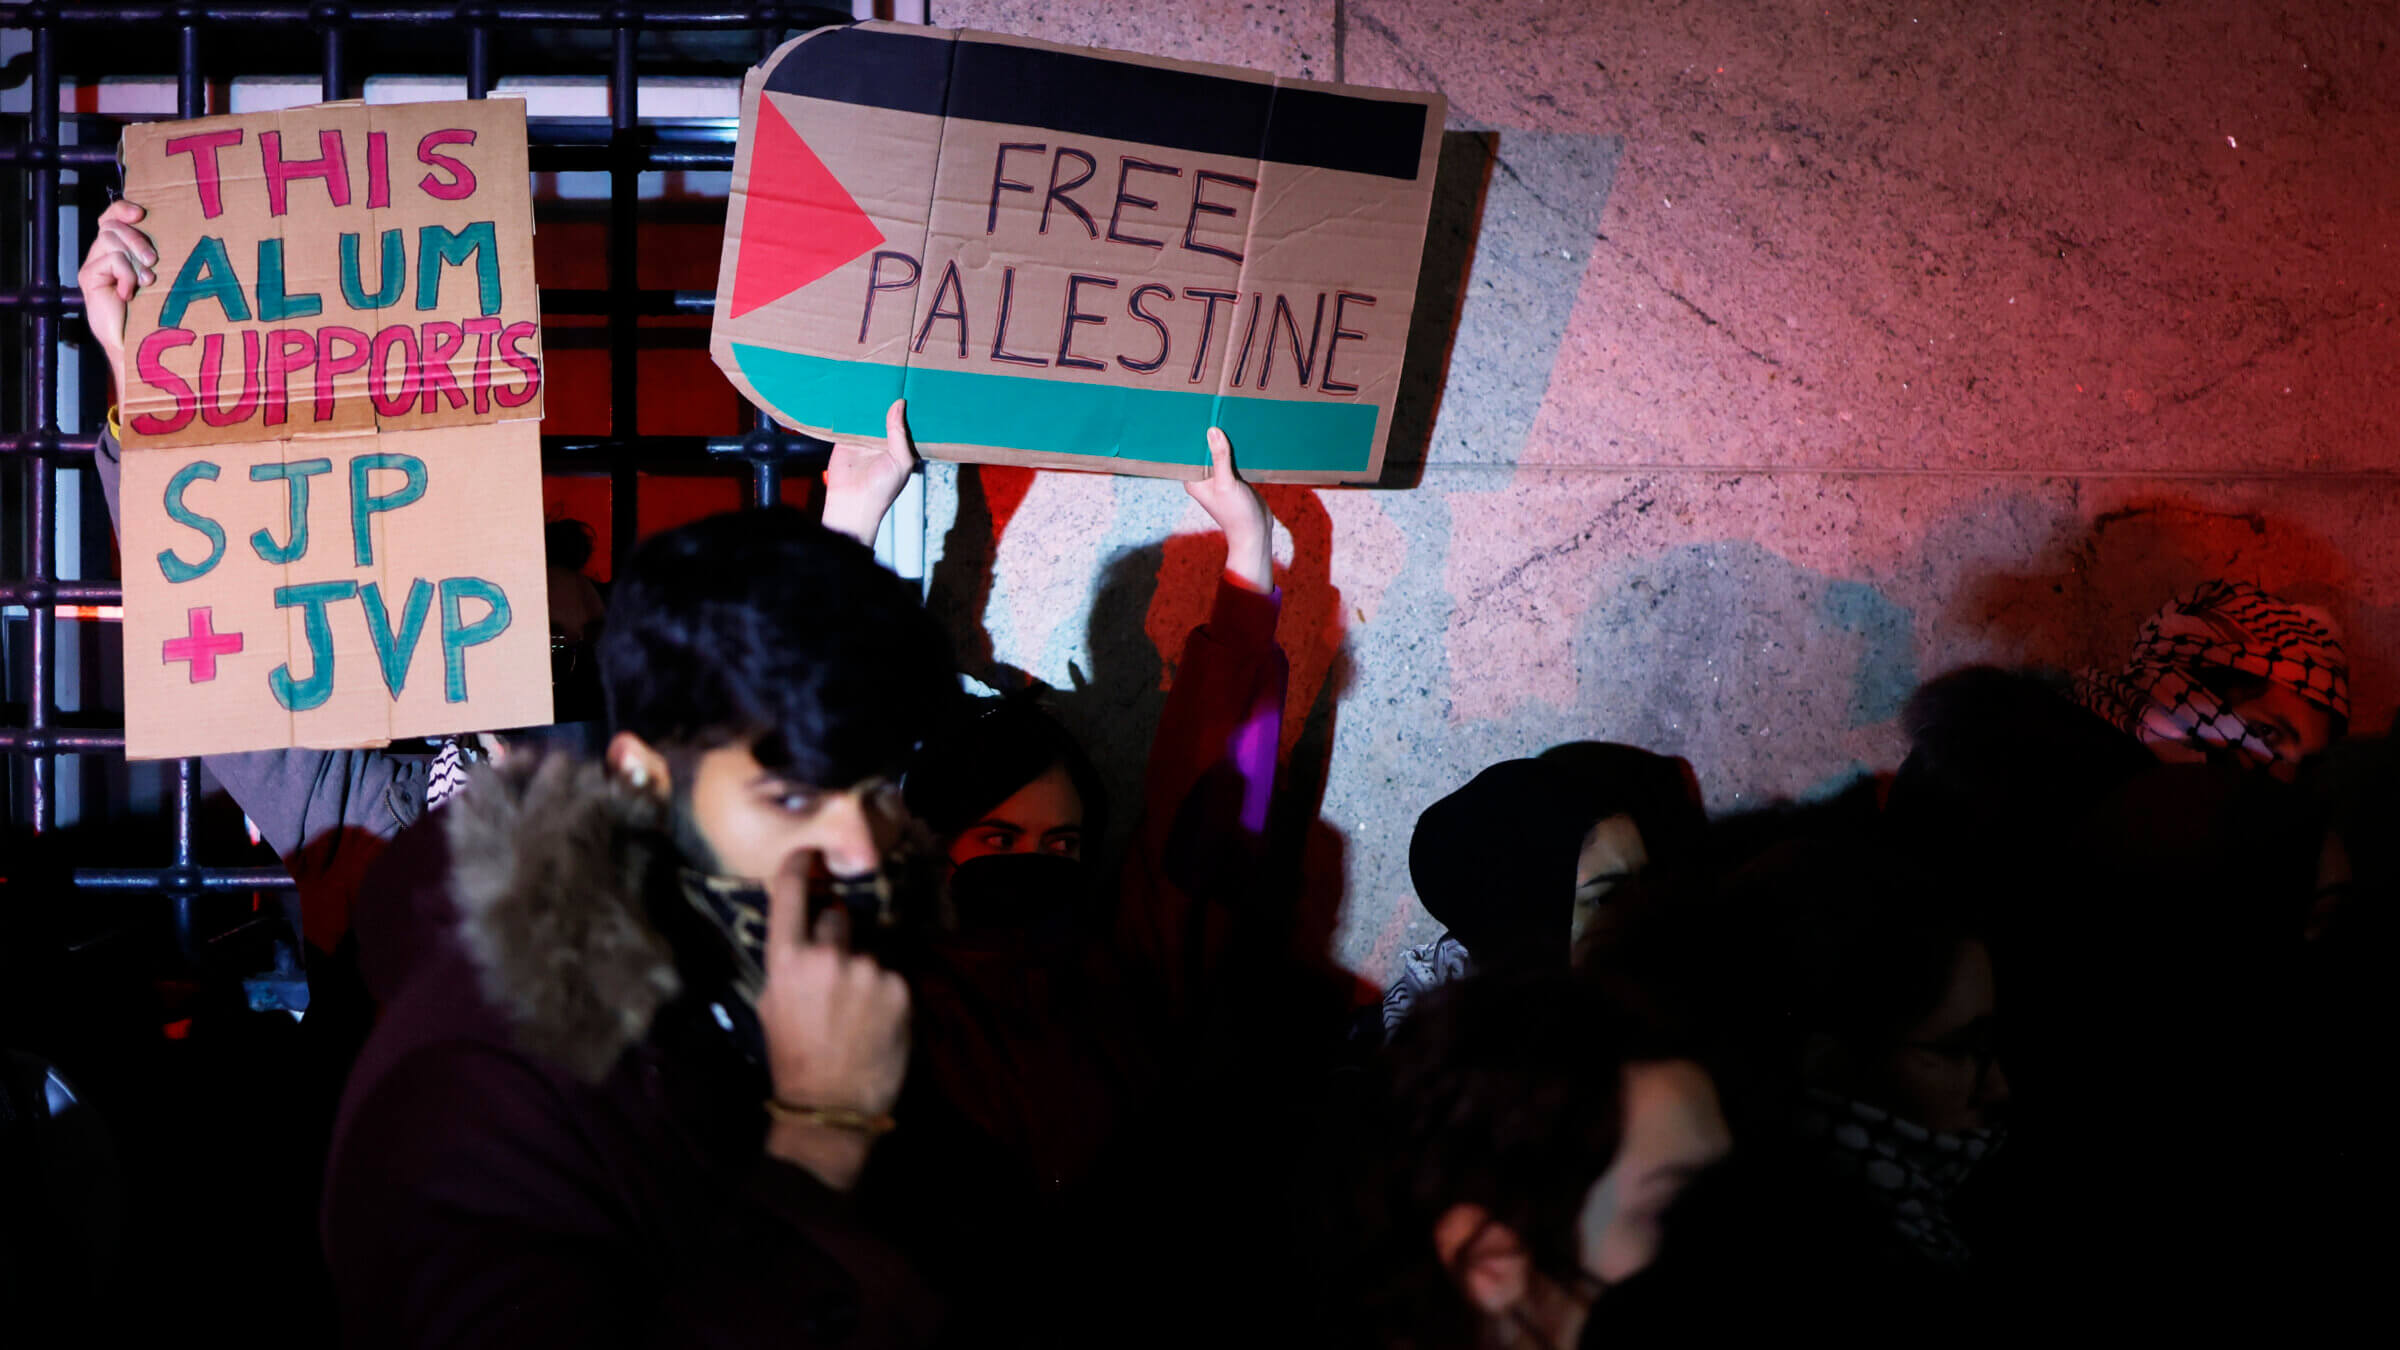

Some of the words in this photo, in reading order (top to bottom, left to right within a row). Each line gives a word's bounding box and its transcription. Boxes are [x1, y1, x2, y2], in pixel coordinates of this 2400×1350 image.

[165, 128, 477, 219] THIS
[986, 142, 1258, 264] FREE
[158, 221, 502, 328] ALUM
[858, 250, 1377, 396] PALESTINE
[129, 317, 541, 435] SUPPORTS
[156, 452, 428, 583] SJP
[162, 606, 244, 684] +
[268, 577, 512, 712] JVP
